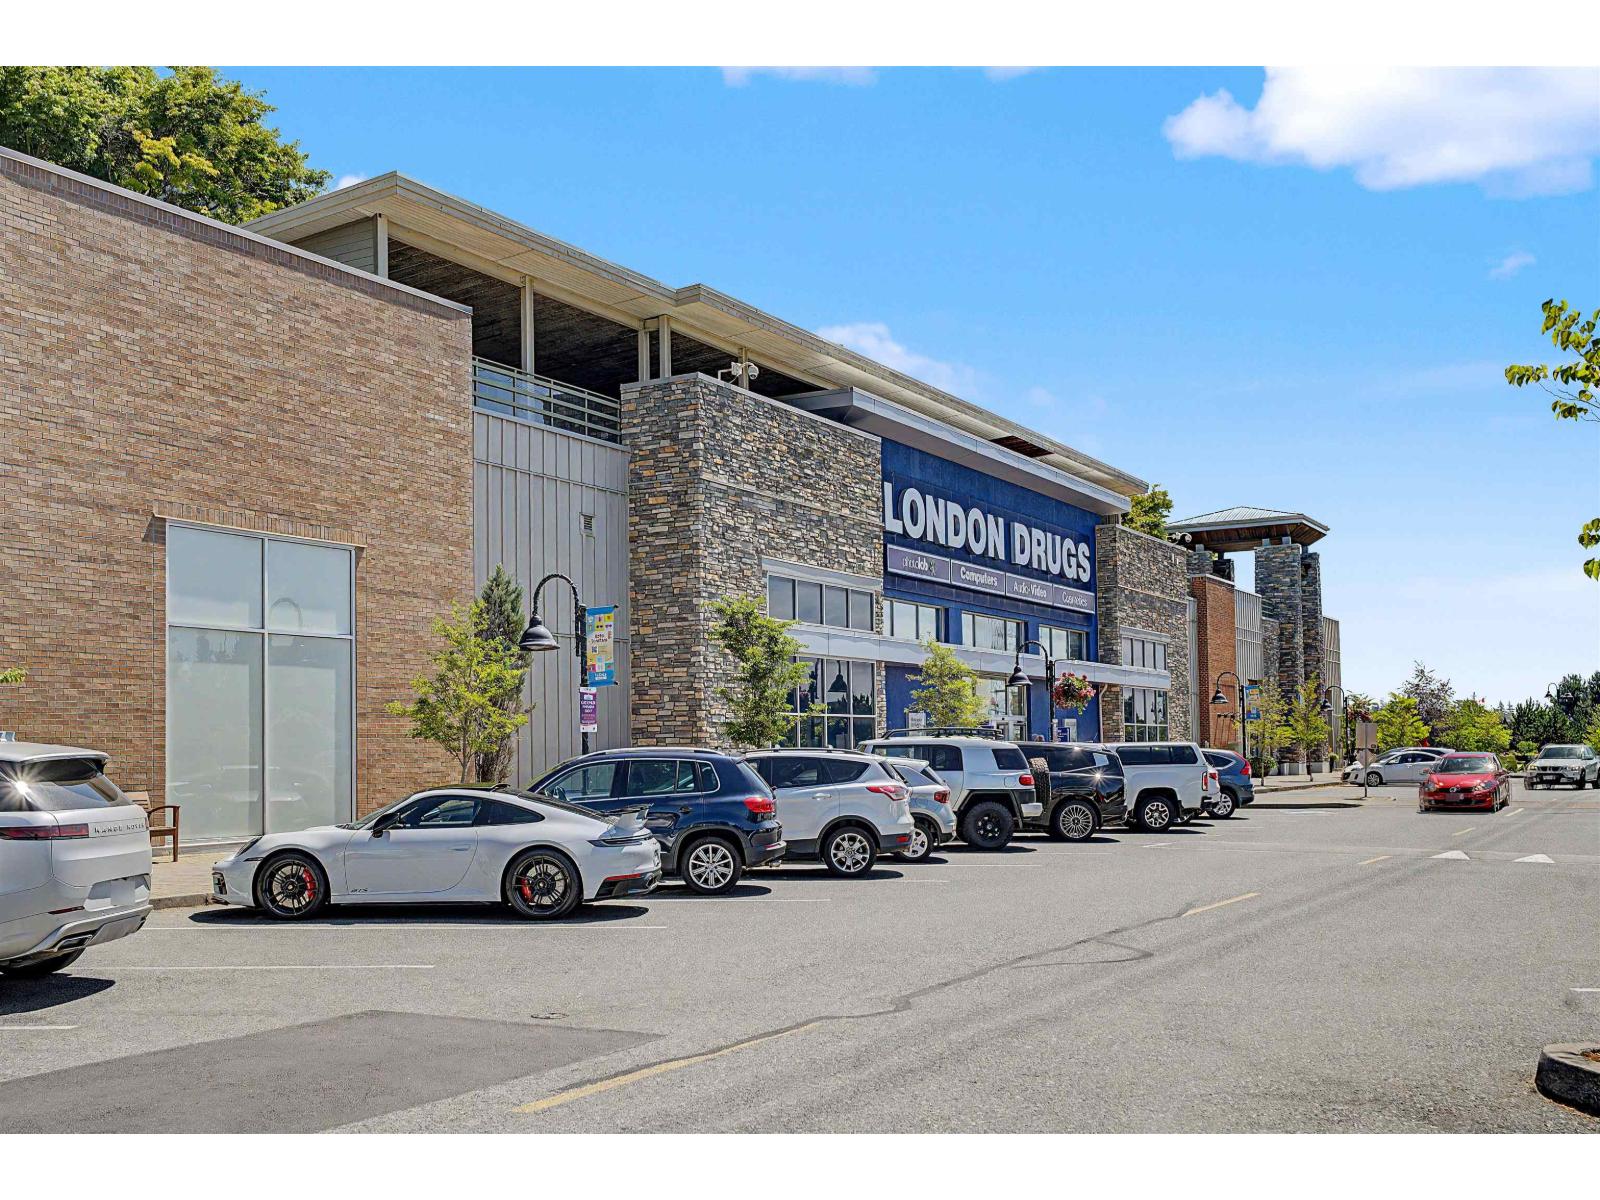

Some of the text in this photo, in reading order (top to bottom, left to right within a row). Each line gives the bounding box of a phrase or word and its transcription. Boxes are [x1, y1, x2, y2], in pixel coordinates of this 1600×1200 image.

[883, 481, 1091, 583] LONDON DRUGS
[960, 566, 998, 586] Computers
